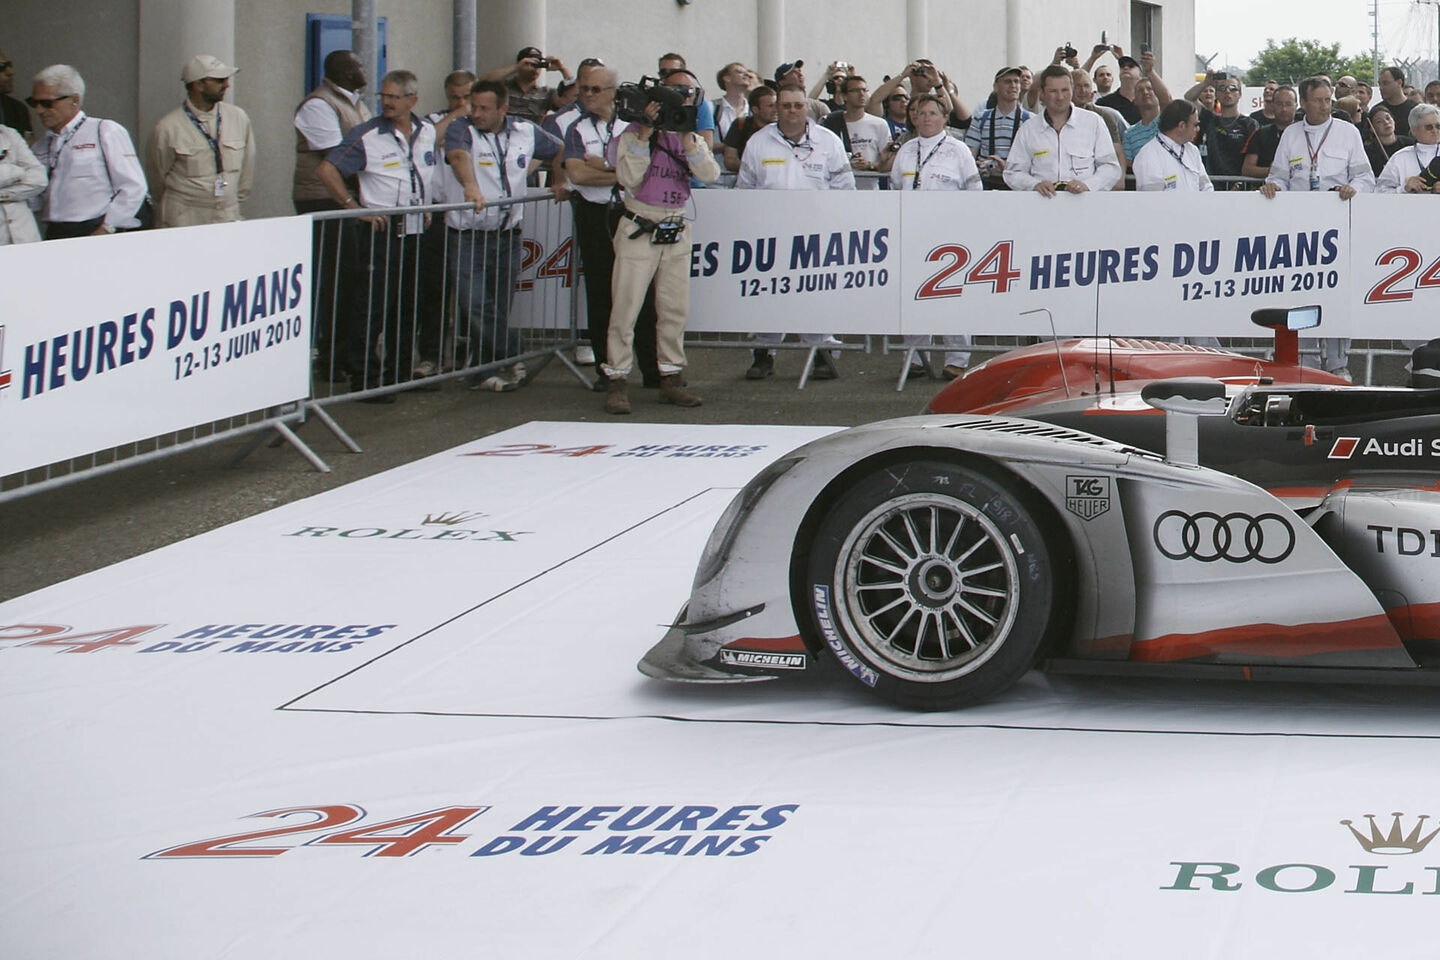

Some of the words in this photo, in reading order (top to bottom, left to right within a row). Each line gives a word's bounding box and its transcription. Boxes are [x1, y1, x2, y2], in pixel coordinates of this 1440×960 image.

[731, 237, 778, 275] DU
[789, 227, 890, 271] MANS
[914, 240, 1021, 301] 24
[1029, 244, 1160, 291] HEURES
[1172, 239, 1220, 279] DU
[1234, 228, 1339, 273] MANS
[740, 276, 791, 297] 12-13
[795, 272, 840, 294] JUIN
[844, 268, 889, 289] 2010
[1181, 280, 1236, 302] 12-13
[1241, 276, 1286, 296] JUIN
[1291, 270, 1338, 292] 2010
[21, 307, 155, 401] HEURES
[167, 290, 210, 351] DU
[221, 262, 303, 333] MANS
[174, 342, 222, 382] 12-13
[225, 332, 262, 364] JUIN
[265, 314, 302, 349] 2010
[456, 444, 617, 458] 24
[630, 444, 769, 452] HEURES
[1362, 438, 1424, 458] Audi
[1073, 477, 1104, 497] TAG
[1069, 499, 1110, 513] HEUER
[282, 527, 537, 543] ROLEX
[0, 624, 169, 655] 24
[181, 624, 398, 641] HEURES
[814, 585, 860, 674] MICHELIN
[136, 641, 218, 655] DU
[222, 641, 375, 655] MANS
[736, 651, 804, 666] MICHELIN
[139, 803, 494, 860] 24
[509, 805, 801, 832] HEURES
[470, 836, 575, 859] DU
[581, 836, 773, 858] MANS
